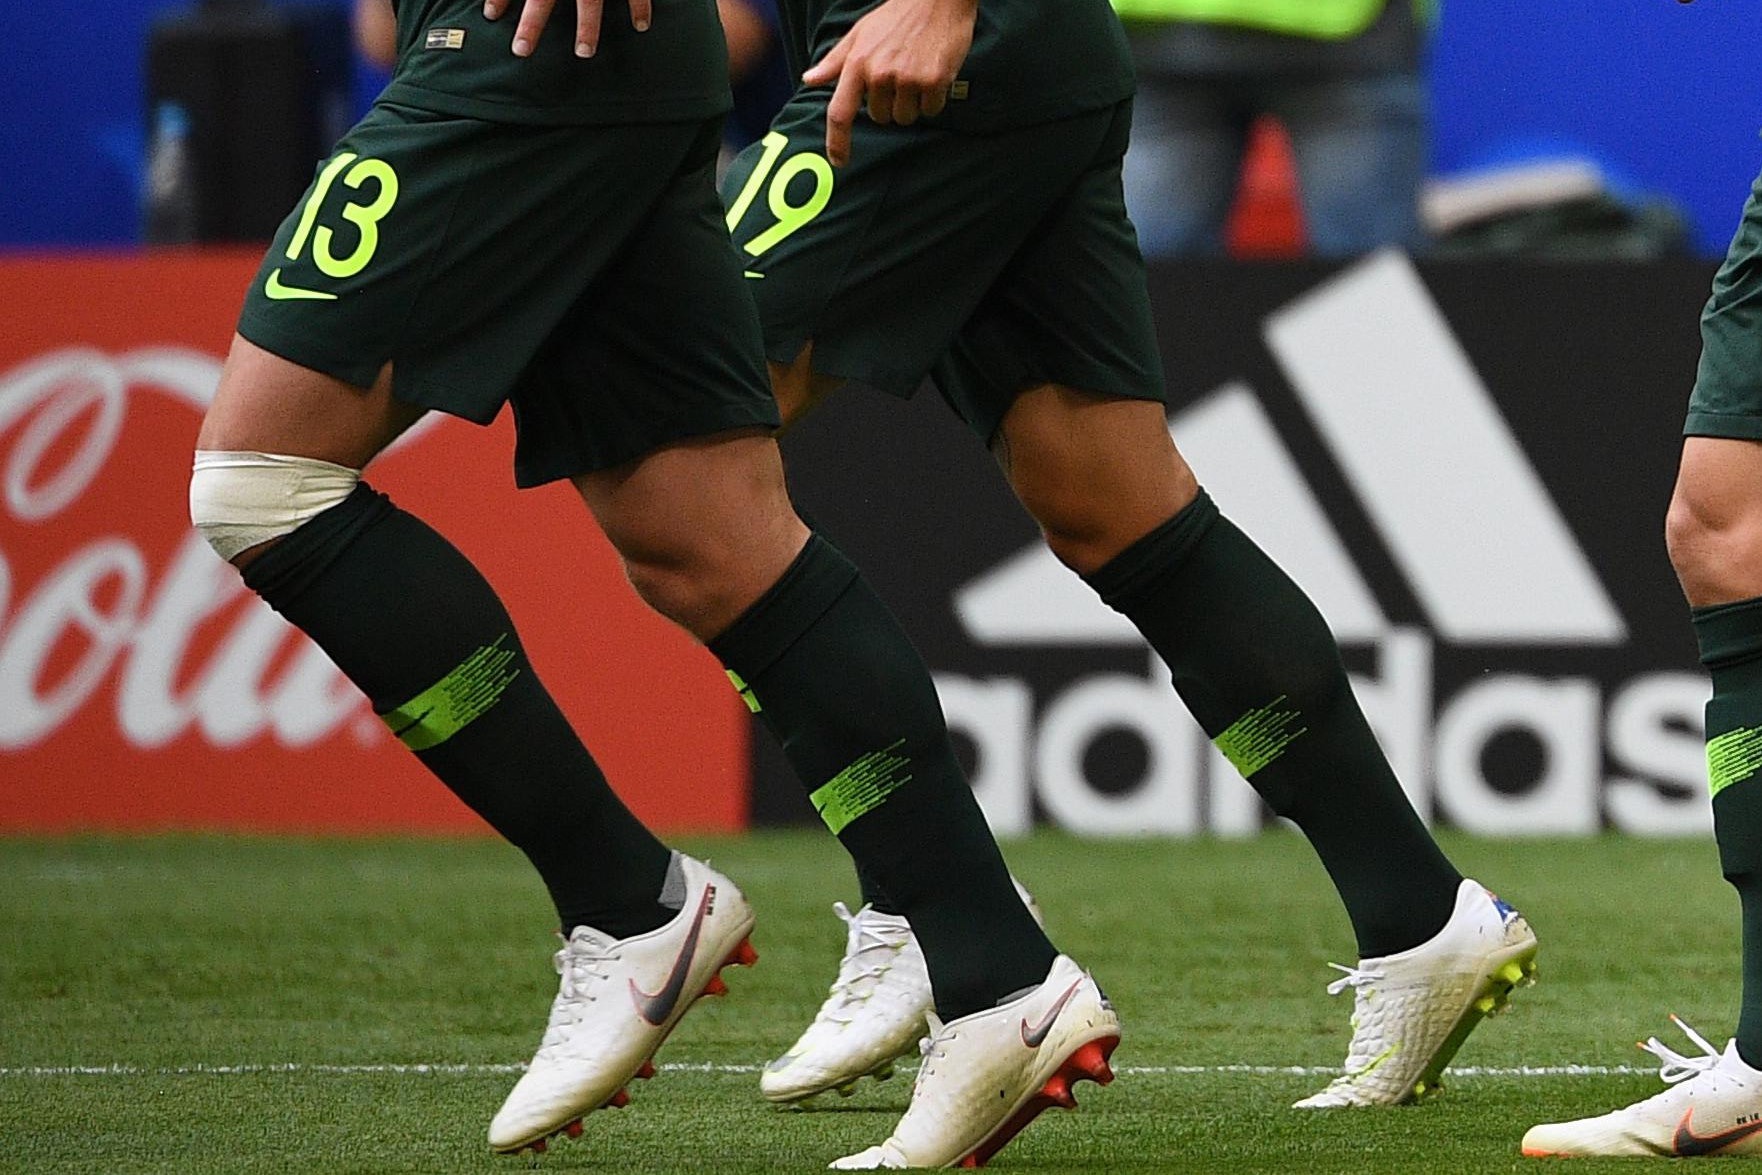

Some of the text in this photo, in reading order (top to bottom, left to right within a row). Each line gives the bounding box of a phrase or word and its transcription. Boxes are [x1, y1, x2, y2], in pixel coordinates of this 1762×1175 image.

[285, 152, 399, 278] 13
[725, 130, 834, 257] 19
[930, 628, 1712, 836] adas
